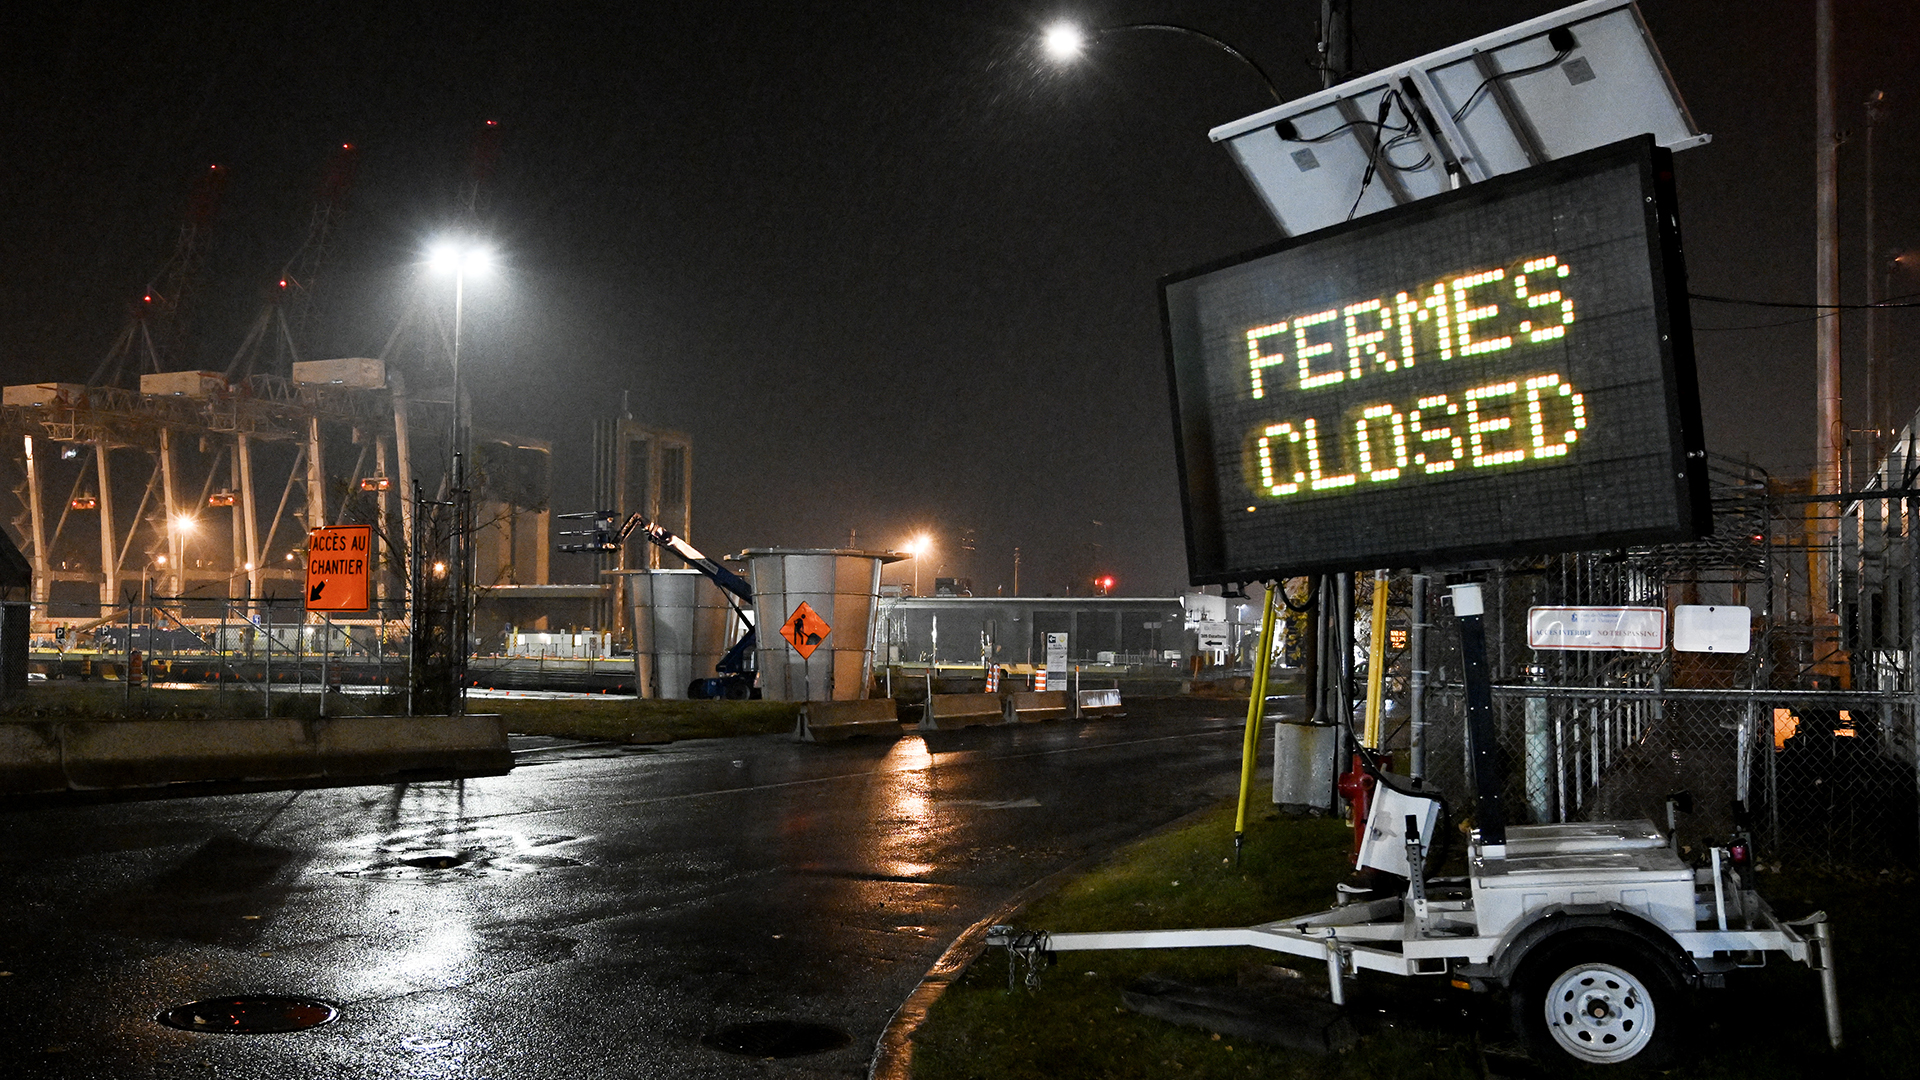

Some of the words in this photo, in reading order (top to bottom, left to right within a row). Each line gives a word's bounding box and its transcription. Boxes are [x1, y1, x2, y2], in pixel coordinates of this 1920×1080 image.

[1247, 255, 1575, 399] FERMES
[1258, 373, 1586, 496] CLOSED
[311, 559, 363, 575] CHANTIER
[312, 533, 346, 551] ACCÈS
[351, 536, 366, 551] AU
